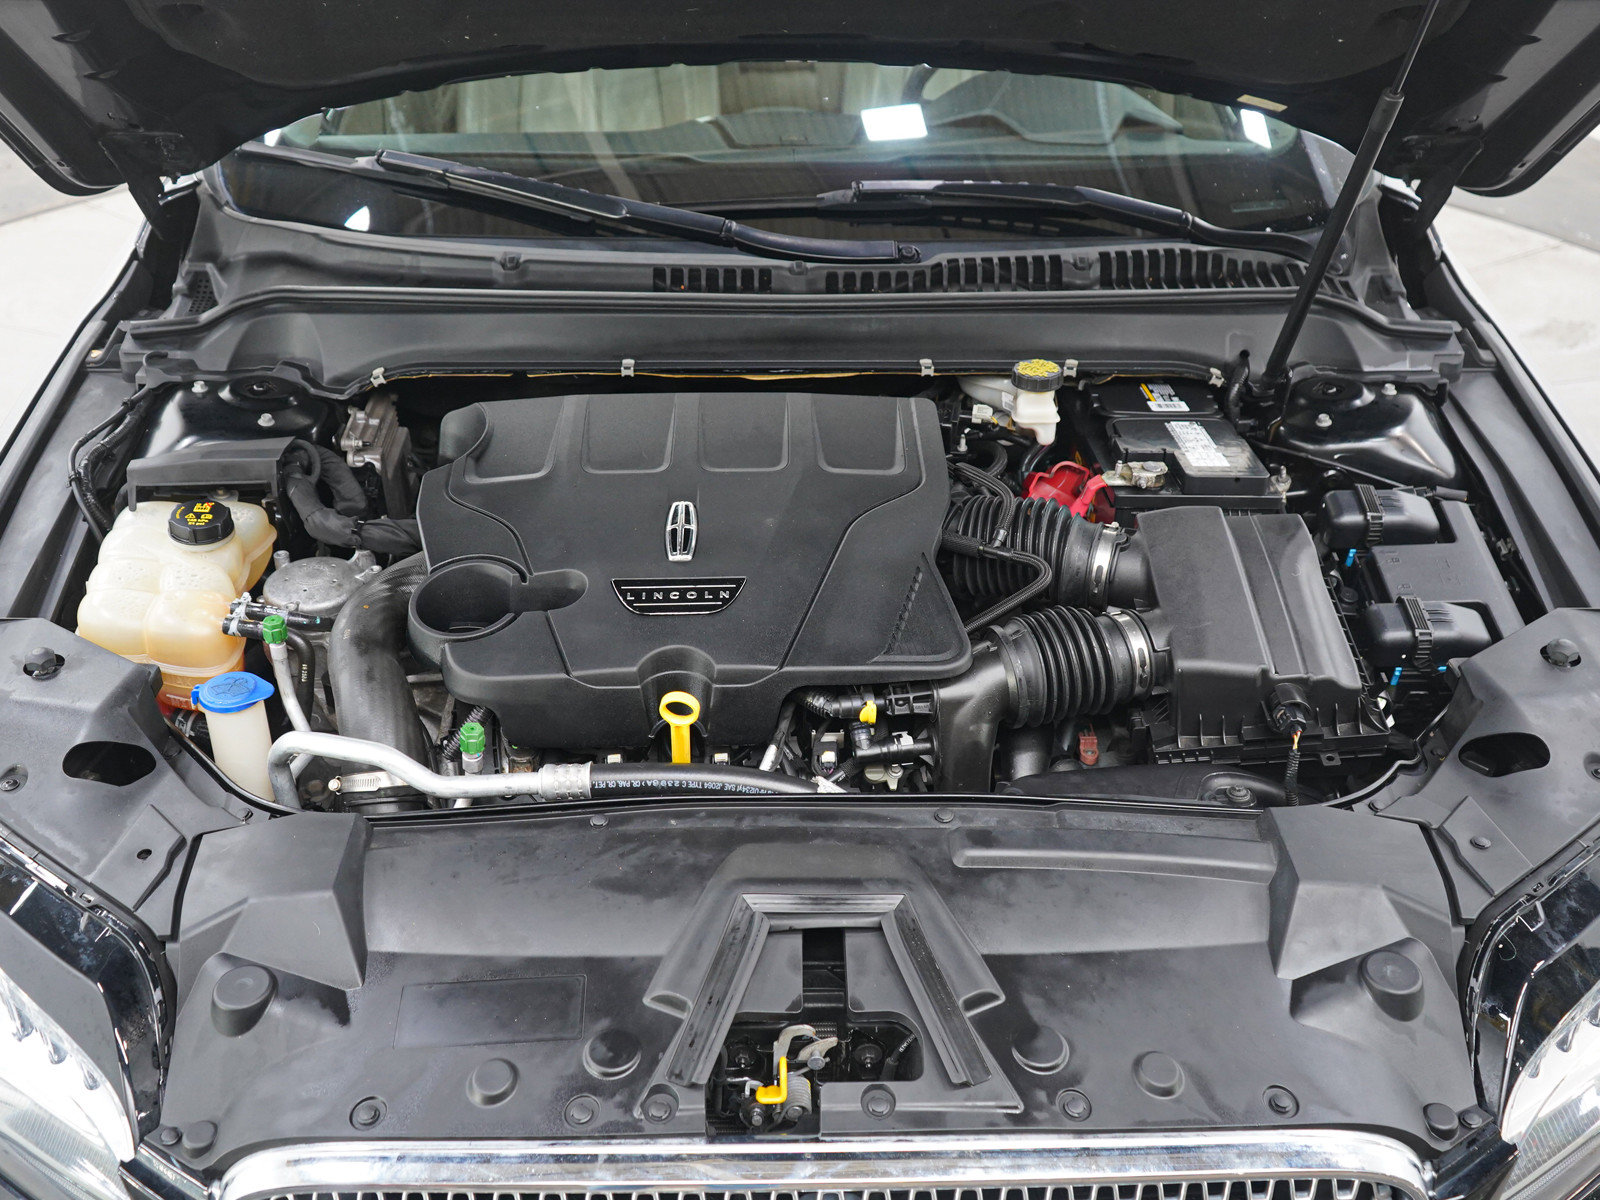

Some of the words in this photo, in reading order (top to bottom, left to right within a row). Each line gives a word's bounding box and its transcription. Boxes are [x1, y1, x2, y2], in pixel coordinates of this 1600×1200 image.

[626, 590, 730, 600] LINCOLN
[687, 780, 702, 789] TYPE
[703, 781, 722, 790] J2064
[724, 782, 736, 791] SAE
